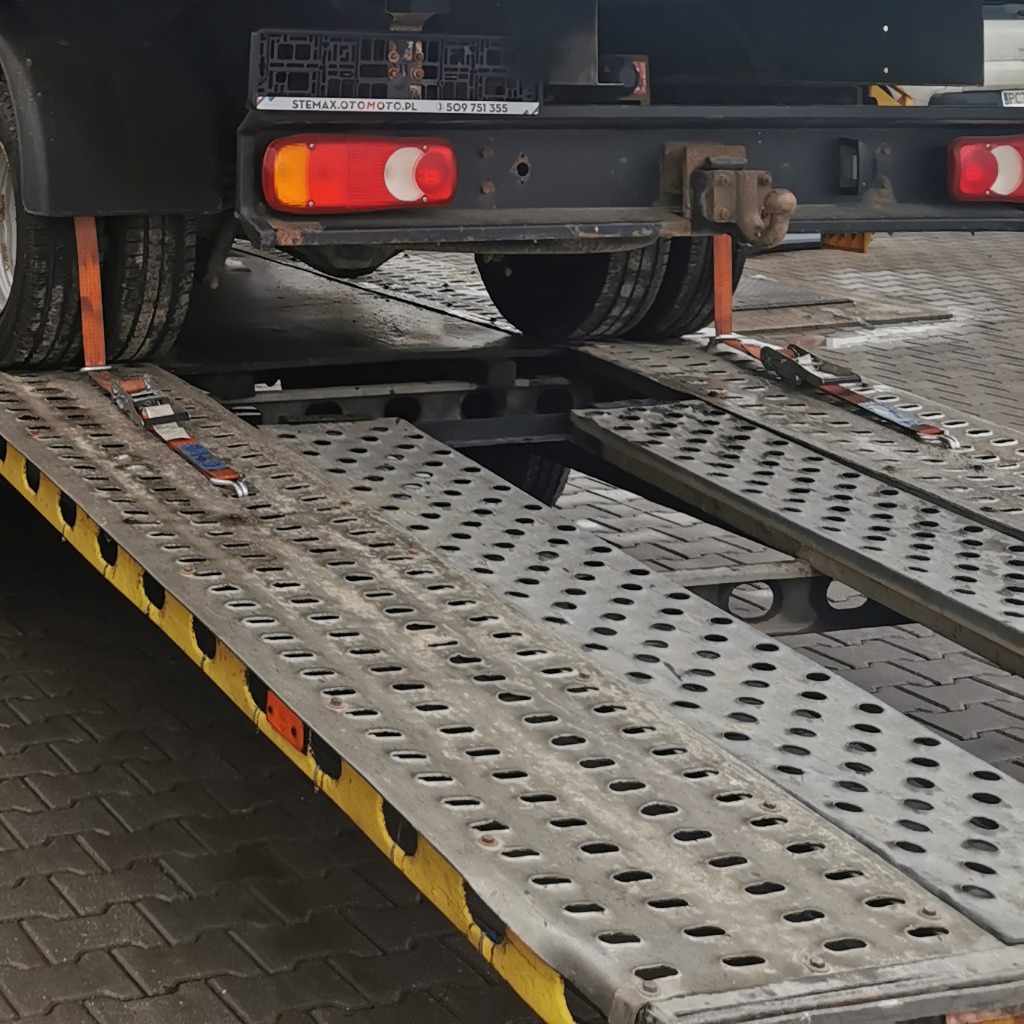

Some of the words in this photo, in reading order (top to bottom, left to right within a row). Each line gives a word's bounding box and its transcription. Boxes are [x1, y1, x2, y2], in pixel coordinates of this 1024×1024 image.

[292, 99, 417, 112] STEMAX.OTOMOTO.PL
[446, 102, 468, 113] 509
[470, 103, 487, 113] 751
[489, 103, 508, 113] 355
